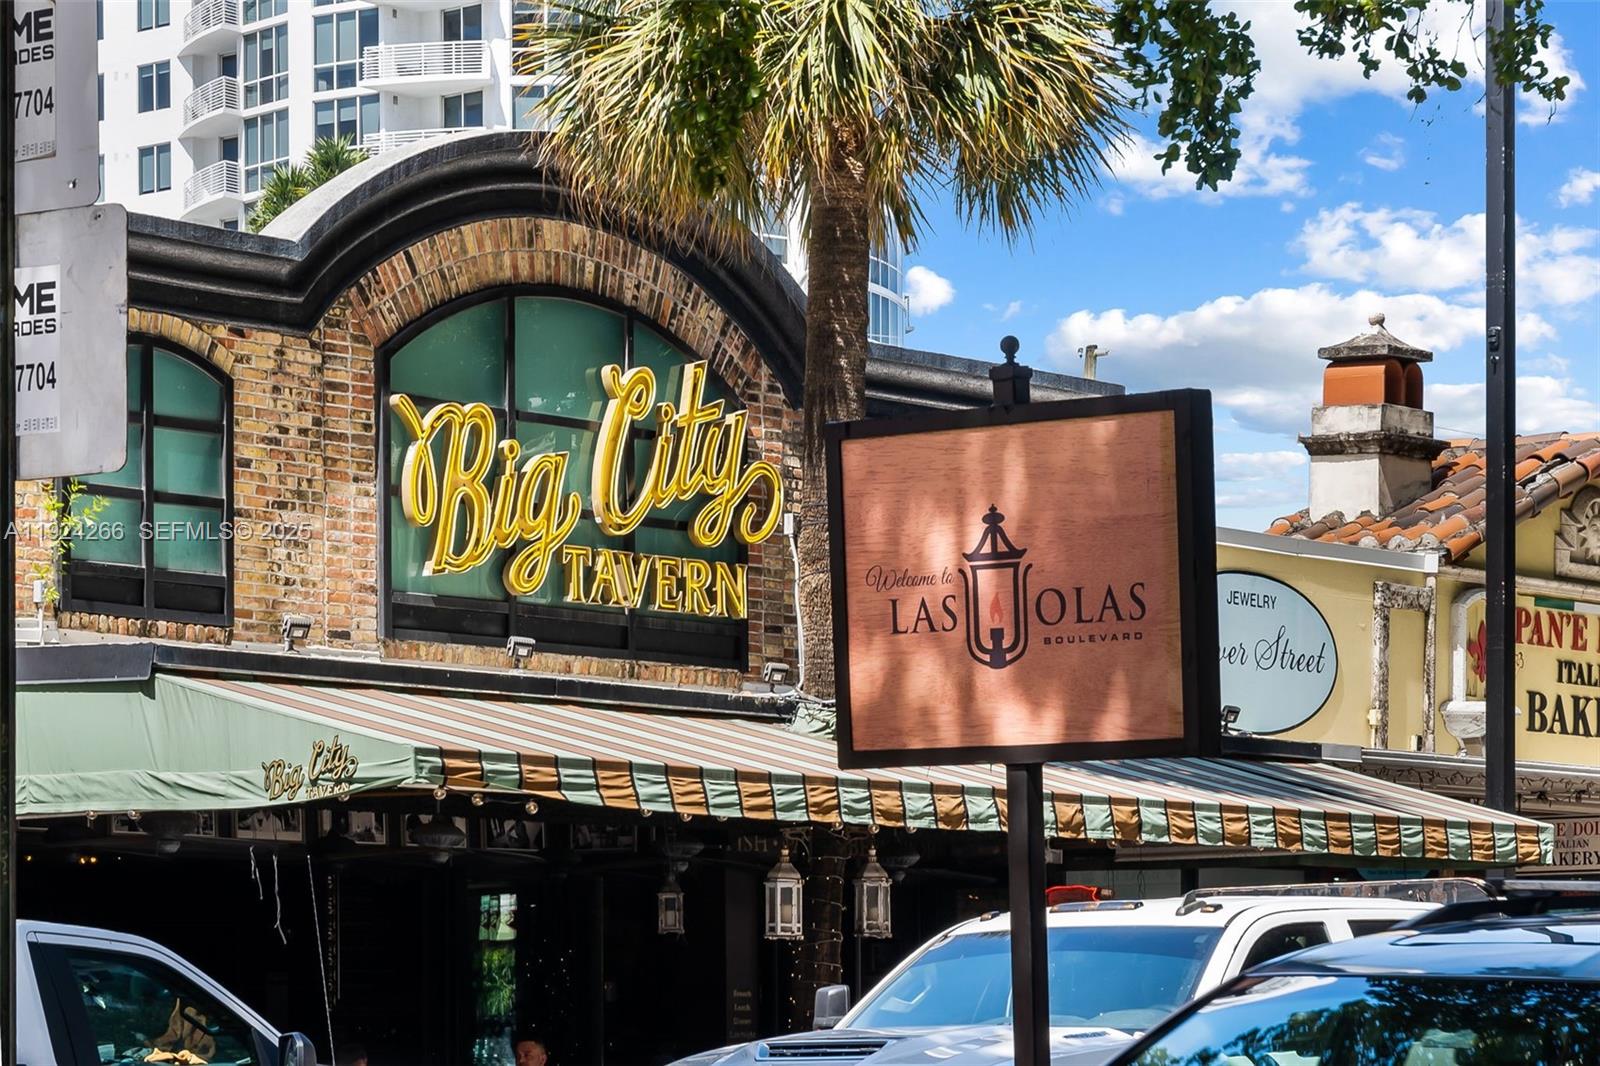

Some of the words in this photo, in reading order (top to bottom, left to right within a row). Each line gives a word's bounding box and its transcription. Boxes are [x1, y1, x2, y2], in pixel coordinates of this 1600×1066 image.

[14, 44, 54, 65] DES
[389, 393, 581, 597] Big
[592, 360, 783, 548] City
[562, 544, 749, 620] TAVERN
[865, 564, 937, 593] Welcome
[941, 566, 954, 585] to
[1226, 590, 1277, 609] JEWELRY
[889, 594, 958, 635] LAS
[1035, 582, 1147, 626] OLAS
[1515, 606, 1588, 651] PAN'E
[1043, 631, 1144, 645] BOULEVARD
[1254, 624, 1326, 674] Street
[261, 758, 305, 801] Big
[308, 735, 359, 781] City
